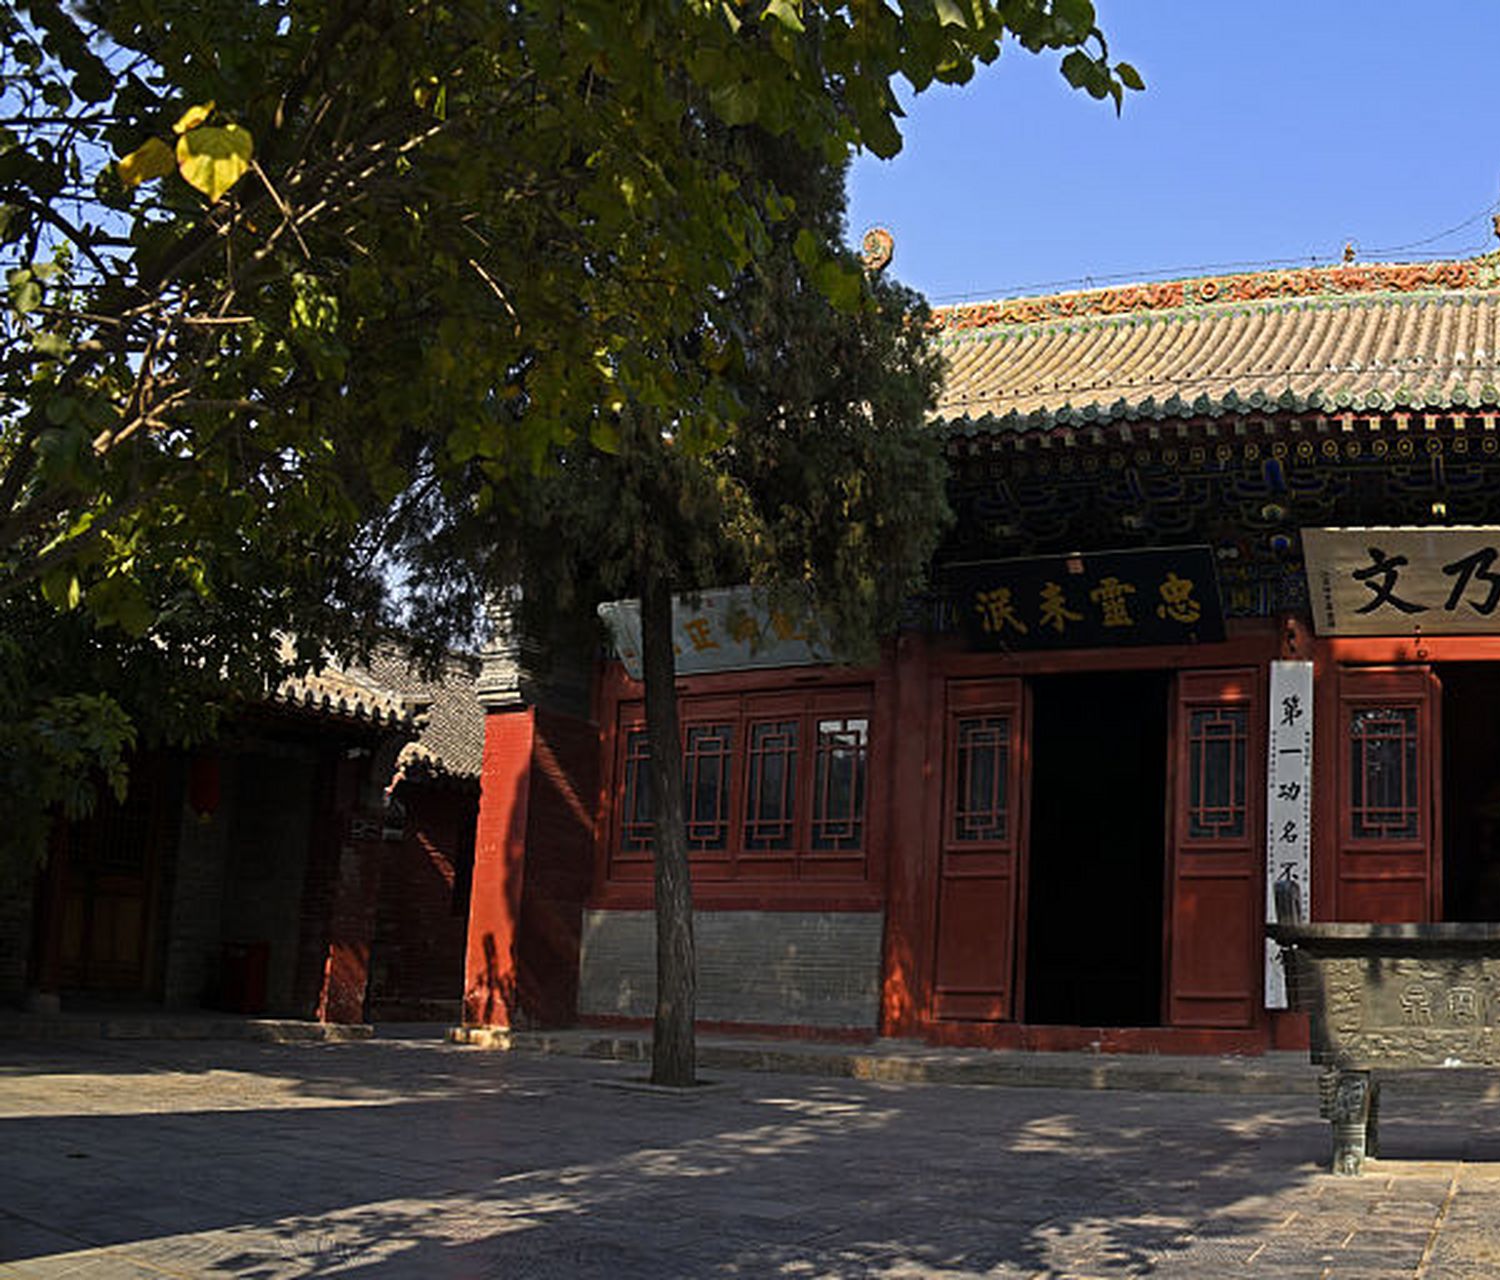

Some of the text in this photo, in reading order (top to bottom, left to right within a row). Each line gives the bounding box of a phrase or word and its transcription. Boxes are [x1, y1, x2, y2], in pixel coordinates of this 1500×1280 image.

[1274, 695, 1304, 967] 第一功名不
